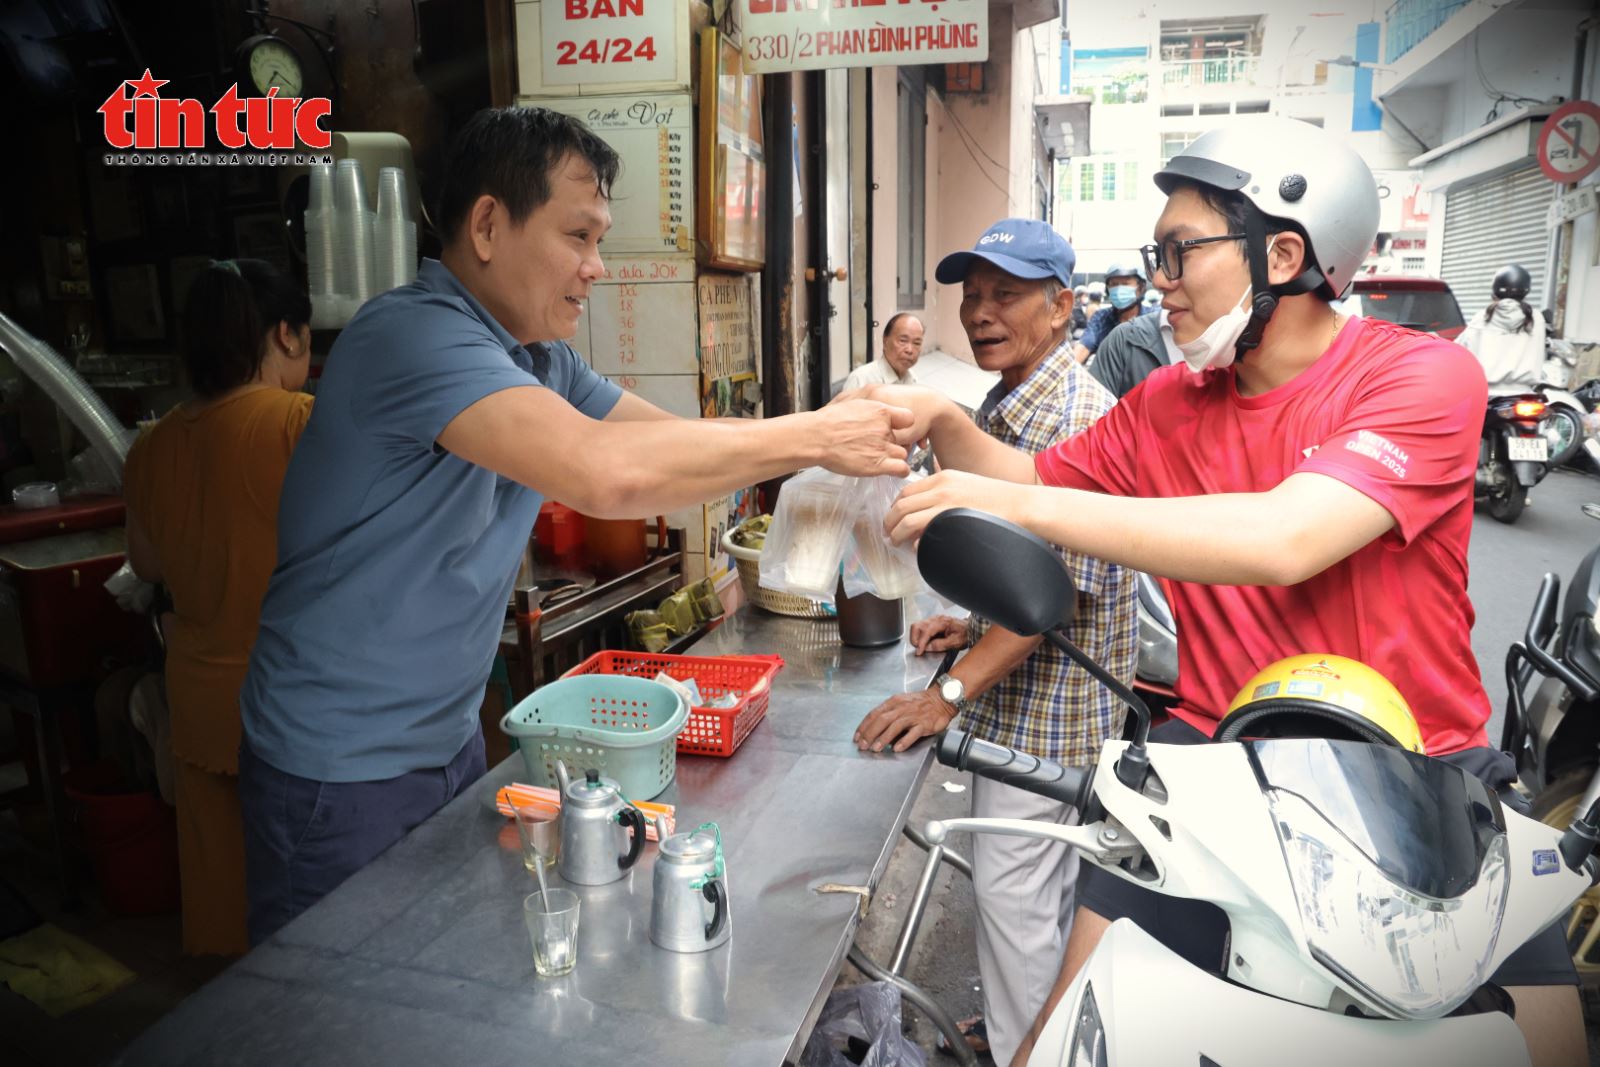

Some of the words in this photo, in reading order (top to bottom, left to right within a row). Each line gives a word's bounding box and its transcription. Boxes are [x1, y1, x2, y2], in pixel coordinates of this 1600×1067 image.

[556, 36, 657, 65] 24/24
[748, 27, 813, 64] 330/2
[816, 29, 865, 56] PHAN
[868, 21, 912, 53] ĐÌNH
[915, 18, 978, 50] PHÙNG
[1344, 440, 1382, 461] OPEN
[1381, 455, 1407, 479] 2025
[1359, 430, 1409, 464] VIETNAM
